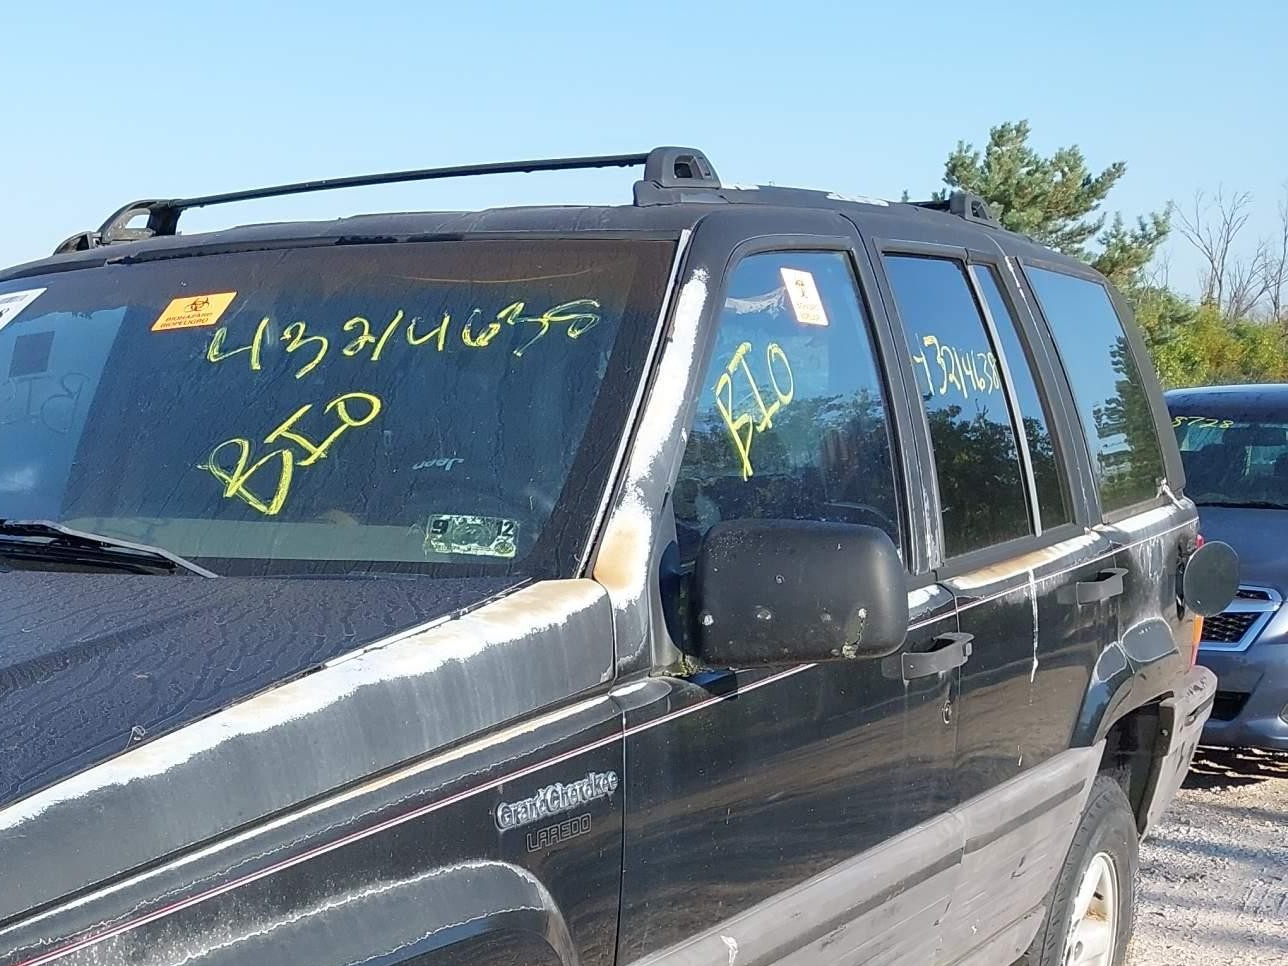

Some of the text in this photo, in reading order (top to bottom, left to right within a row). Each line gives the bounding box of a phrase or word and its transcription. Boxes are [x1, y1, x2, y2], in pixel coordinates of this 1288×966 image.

[196, 391, 383, 515] BIO
[715, 342, 794, 482] BIO
[526, 813, 592, 852] LAREDO
